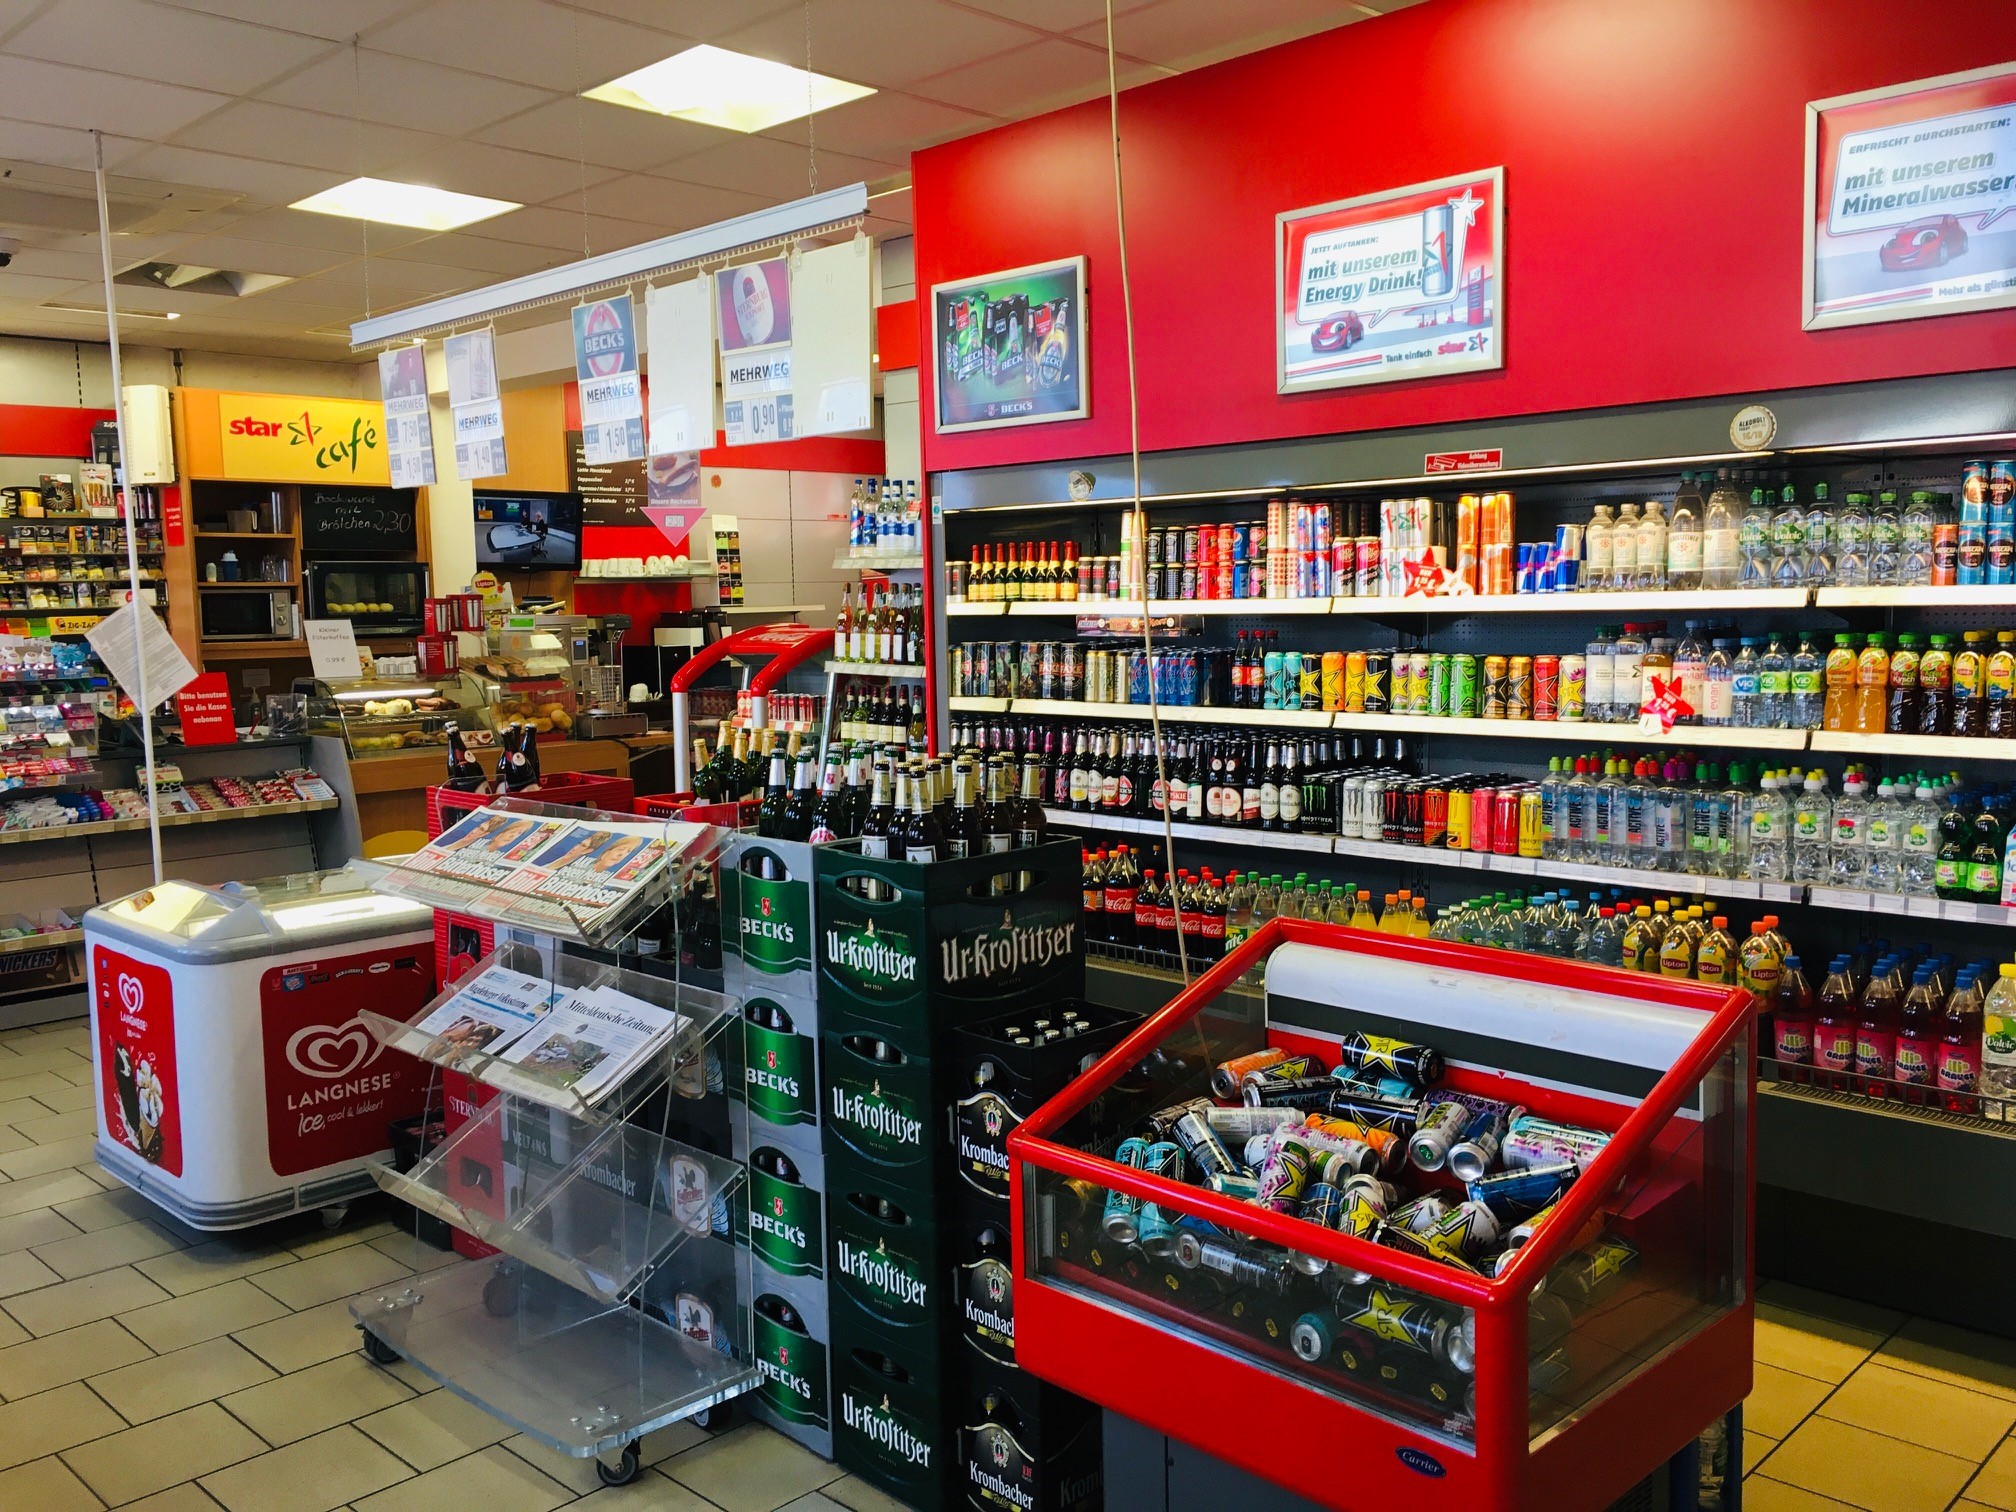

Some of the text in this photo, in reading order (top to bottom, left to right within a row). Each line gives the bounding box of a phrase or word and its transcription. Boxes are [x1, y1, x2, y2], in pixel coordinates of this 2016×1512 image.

[1848, 117, 2012, 155] ERFRISCHT DURCHSTARTEN:
[1844, 151, 1995, 191] mit unserem
[1841, 173, 2016, 217] Mineralwasser
[1310, 236, 1379, 255] JETZT AUFTANKEN:
[1307, 260, 1338, 280] mit
[1341, 249, 1418, 275] unserem
[1304, 281, 1363, 304] Energy
[1367, 268, 1424, 295] Drink!
[1938, 276, 2016, 297] Mehr als günsti
[585, 332, 625, 354] BECK'S
[1437, 341, 1467, 356] star
[1385, 349, 1432, 364] Tank einfach
[730, 362, 790, 383] MEHRWEG
[586, 382, 635, 403] MEHRWEG
[387, 397, 424, 413] MEHRWEG
[1001, 400, 1034, 414] BECK'S
[229, 416, 283, 438] star
[458, 412, 499, 430] MEHRWEG
[315, 416, 379, 475] café
[372, 509, 412, 535] 2,30
[1774, 531, 1802, 541] Volvic
[1921, 674, 1937, 682] irsch
[179, 690, 228, 701] Bitte benutzen
[183, 702, 228, 712] Sie die Kasse
[1710, 683, 1719, 710] evian
[193, 715, 223, 724] nebenan
[1170, 792, 1187, 800] YSKIE
[1569, 800, 1582, 829] ACTIVE
[1596, 802, 1609, 830] ACTIVE
[1628, 805, 1642, 834] ACTIVE
[1718, 810, 1727, 840] ACTIVE
[1655, 823, 1665, 848] ACTIVE
[739, 916, 795, 943] BECK'S
[1662, 960, 1686, 969] Lipton
[1753, 970, 1778, 979] Lipton
[564, 998, 660, 1035] Mitteldeutsche Zeitung
[746, 1066, 799, 1098] BECK'S
[1940, 1068, 1975, 1080] BRAUSE
[287, 1072, 391, 1111] LANGNESE
[327, 1105, 346, 1123] cool
[961, 1134, 1010, 1171] Krombac
[750, 1210, 806, 1249] BECK'S
[756, 1357, 811, 1400] BECK'S
[1402, 1450, 1440, 1473] Carrier
[969, 1460, 1034, 1511] Krombacher
